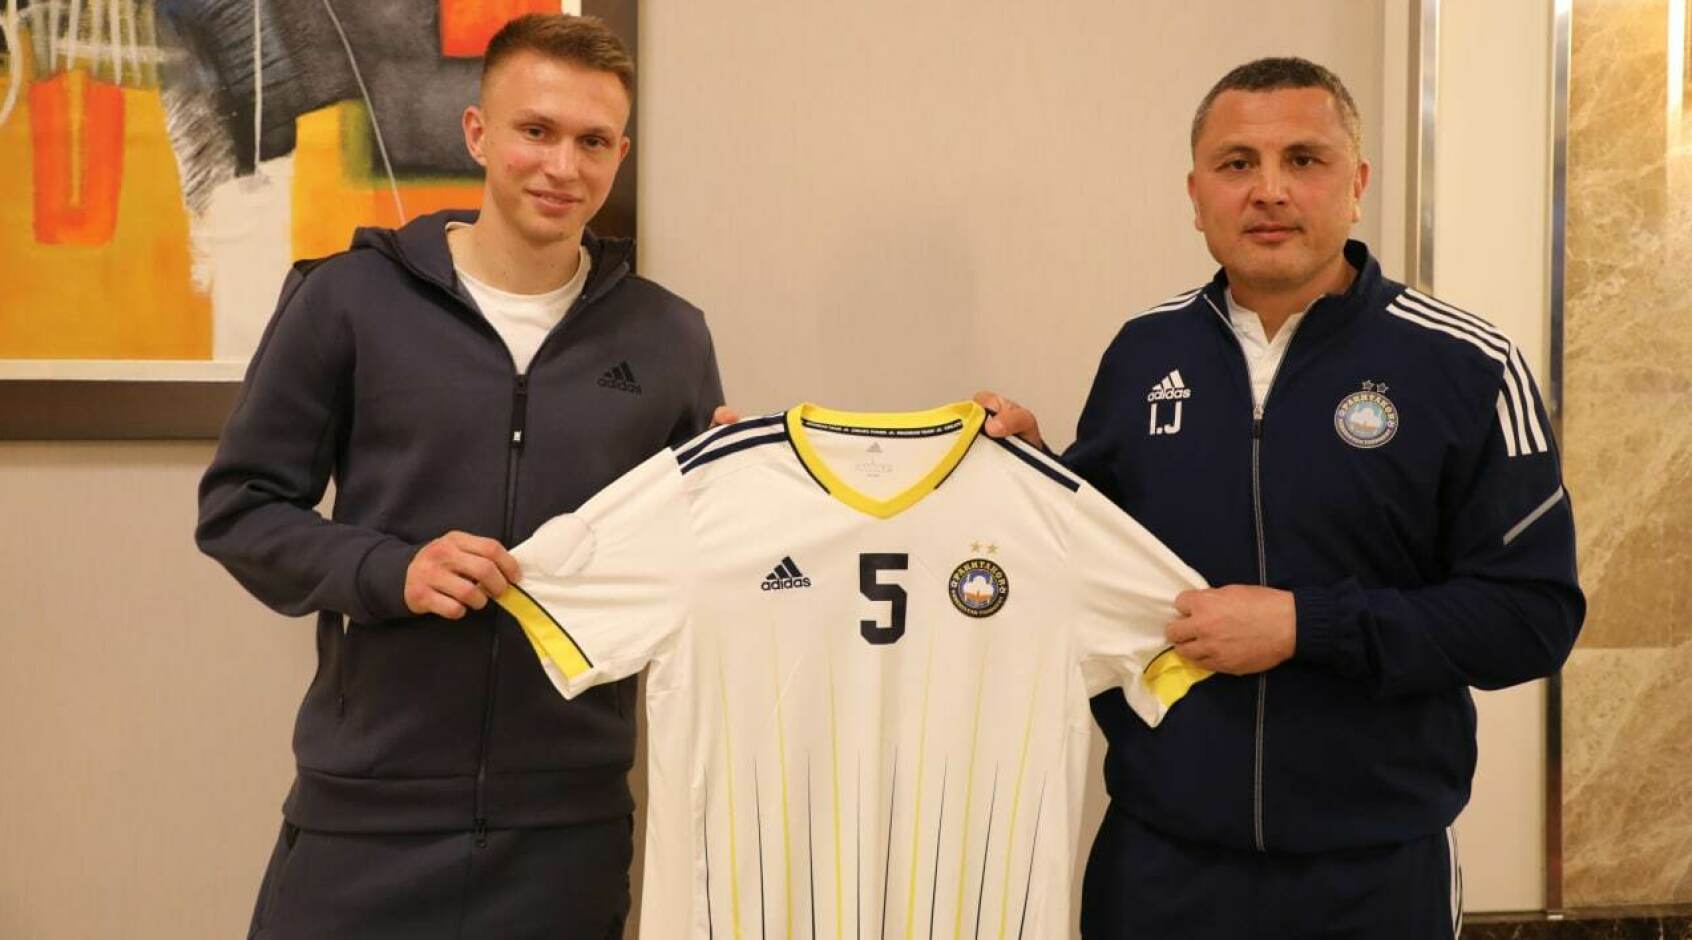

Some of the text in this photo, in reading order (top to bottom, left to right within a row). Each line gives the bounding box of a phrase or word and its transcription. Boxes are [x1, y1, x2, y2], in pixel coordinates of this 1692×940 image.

[596, 378, 642, 393] adidas
[1148, 388, 1191, 402] adidas
[1150, 400, 1182, 435] I.J
[761, 577, 811, 591] adidas
[859, 552, 908, 645] 5
